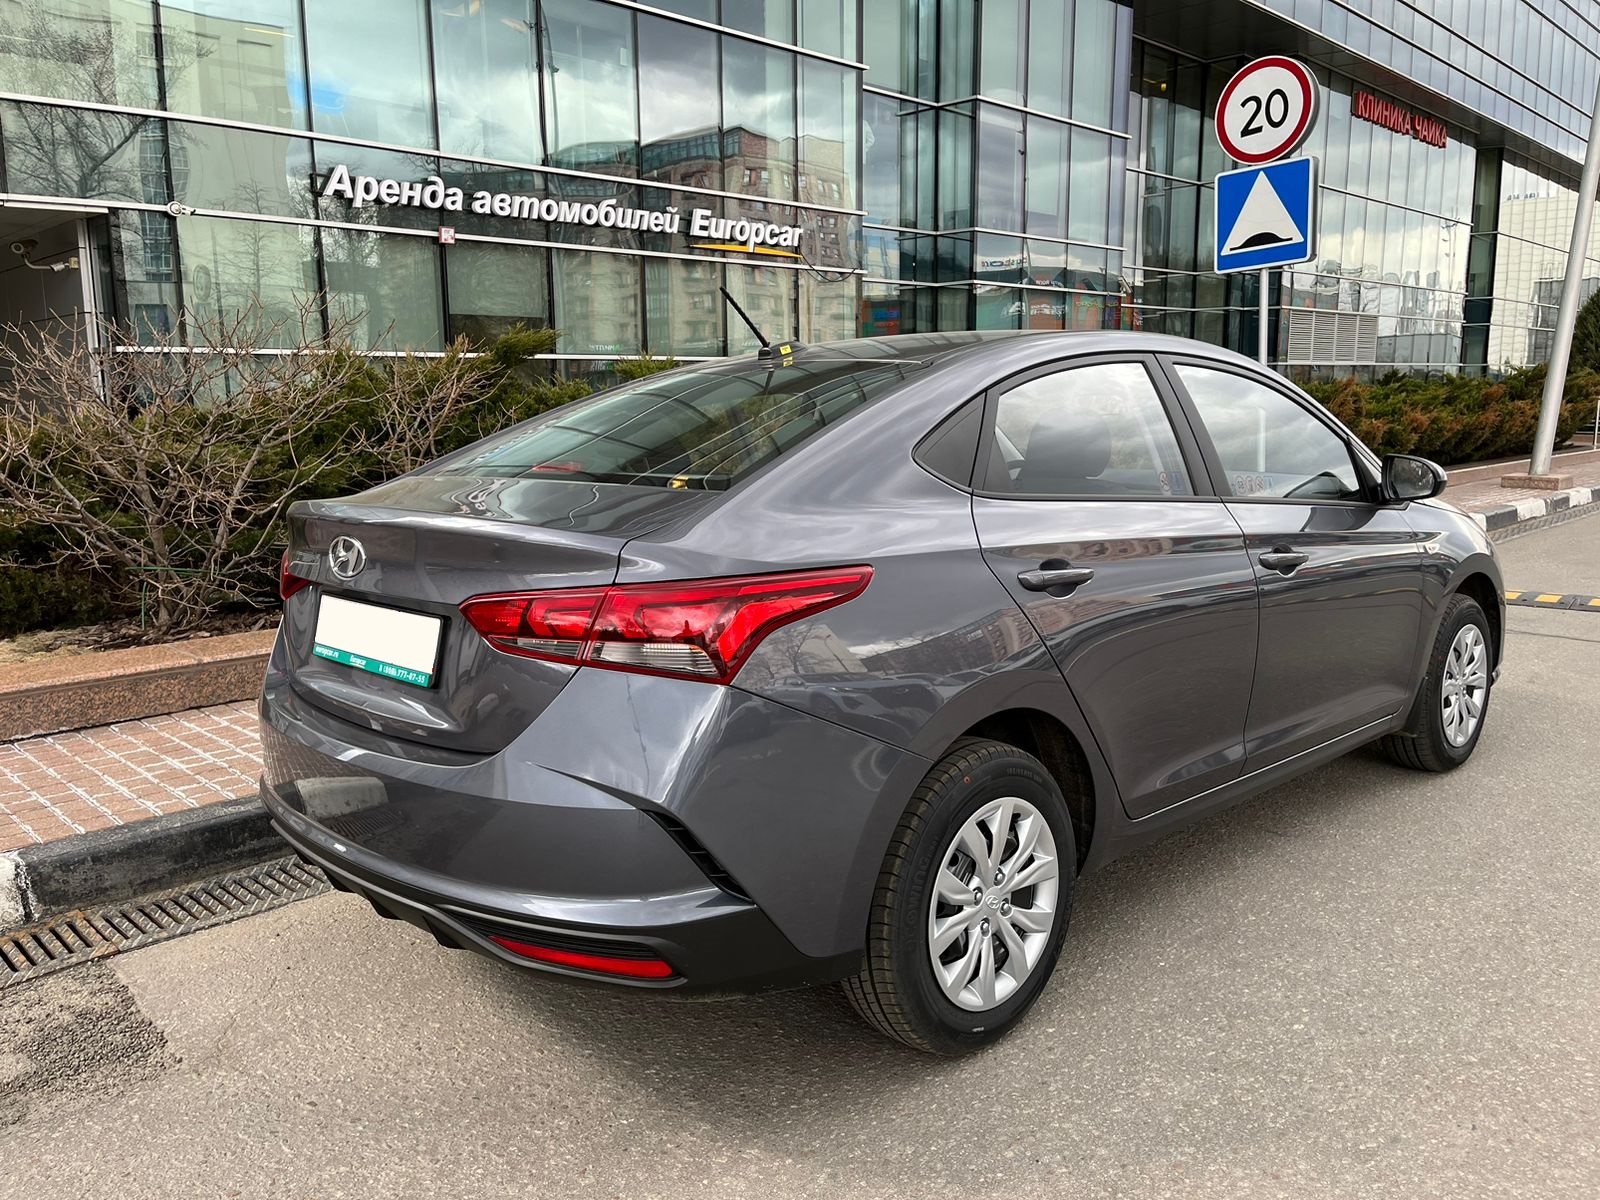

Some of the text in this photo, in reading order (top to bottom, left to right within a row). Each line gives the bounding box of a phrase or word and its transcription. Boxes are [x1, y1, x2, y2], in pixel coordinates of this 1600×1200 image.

[1240, 88, 1289, 138] 20
[1357, 91, 1448, 148] КЛИНИКА ЧАЙКА
[322, 164, 804, 253] Аренда автомобилей Europcar
